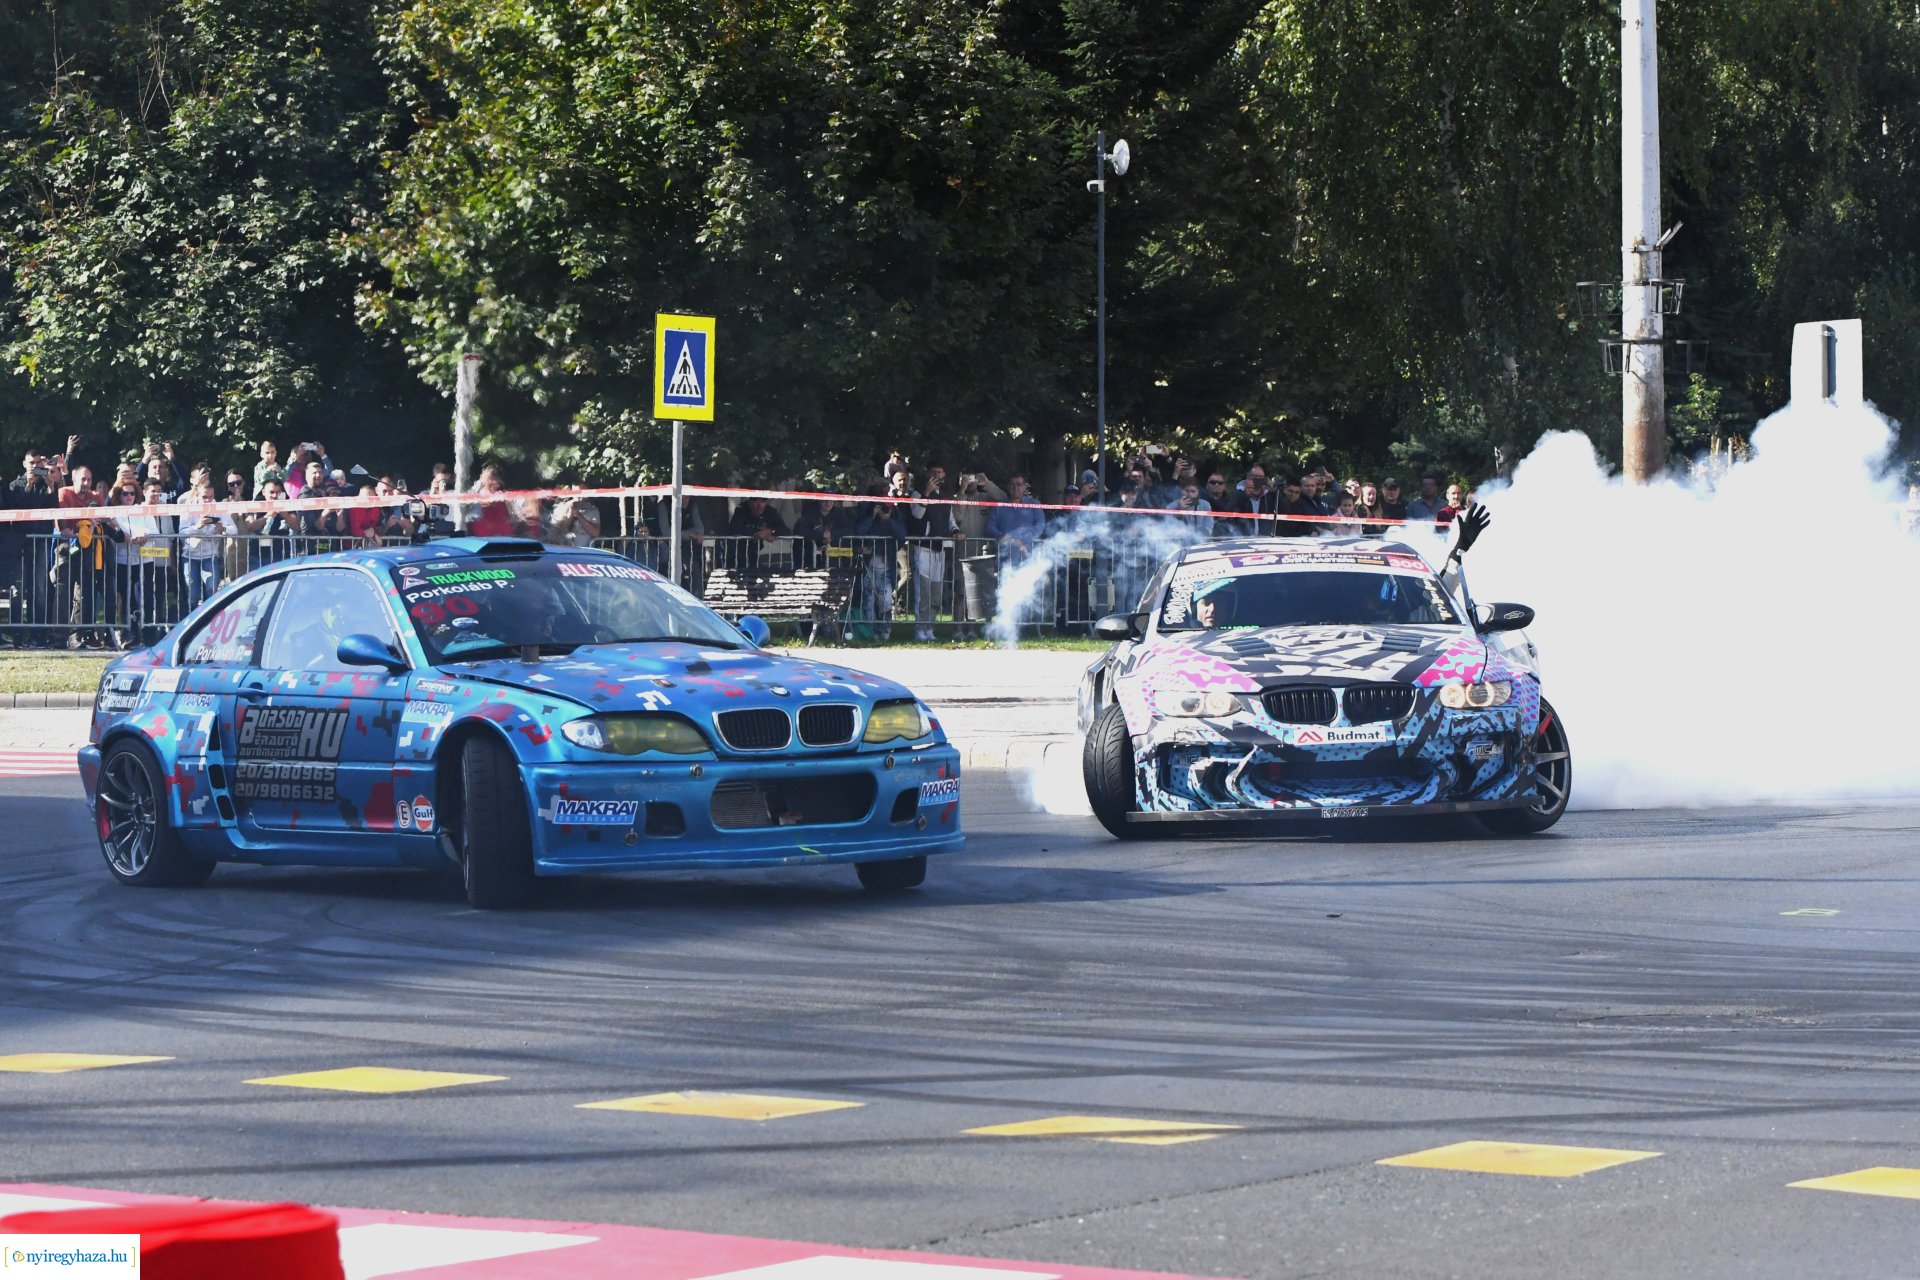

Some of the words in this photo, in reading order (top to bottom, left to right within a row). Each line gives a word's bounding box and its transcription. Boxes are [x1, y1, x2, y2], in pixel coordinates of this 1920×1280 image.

[1390, 559, 1424, 570] 300
[426, 570, 516, 585] TRACKWOOD
[405, 582, 493, 604] Porkoláb
[494, 579, 515, 589] P.
[410, 596, 480, 624] 90
[206, 609, 241, 645] 90
[405, 701, 451, 716] MAKRAI
[401, 805, 409, 821] E
[414, 807, 434, 819] Gulf
[556, 800, 638, 815] MAKRAI
